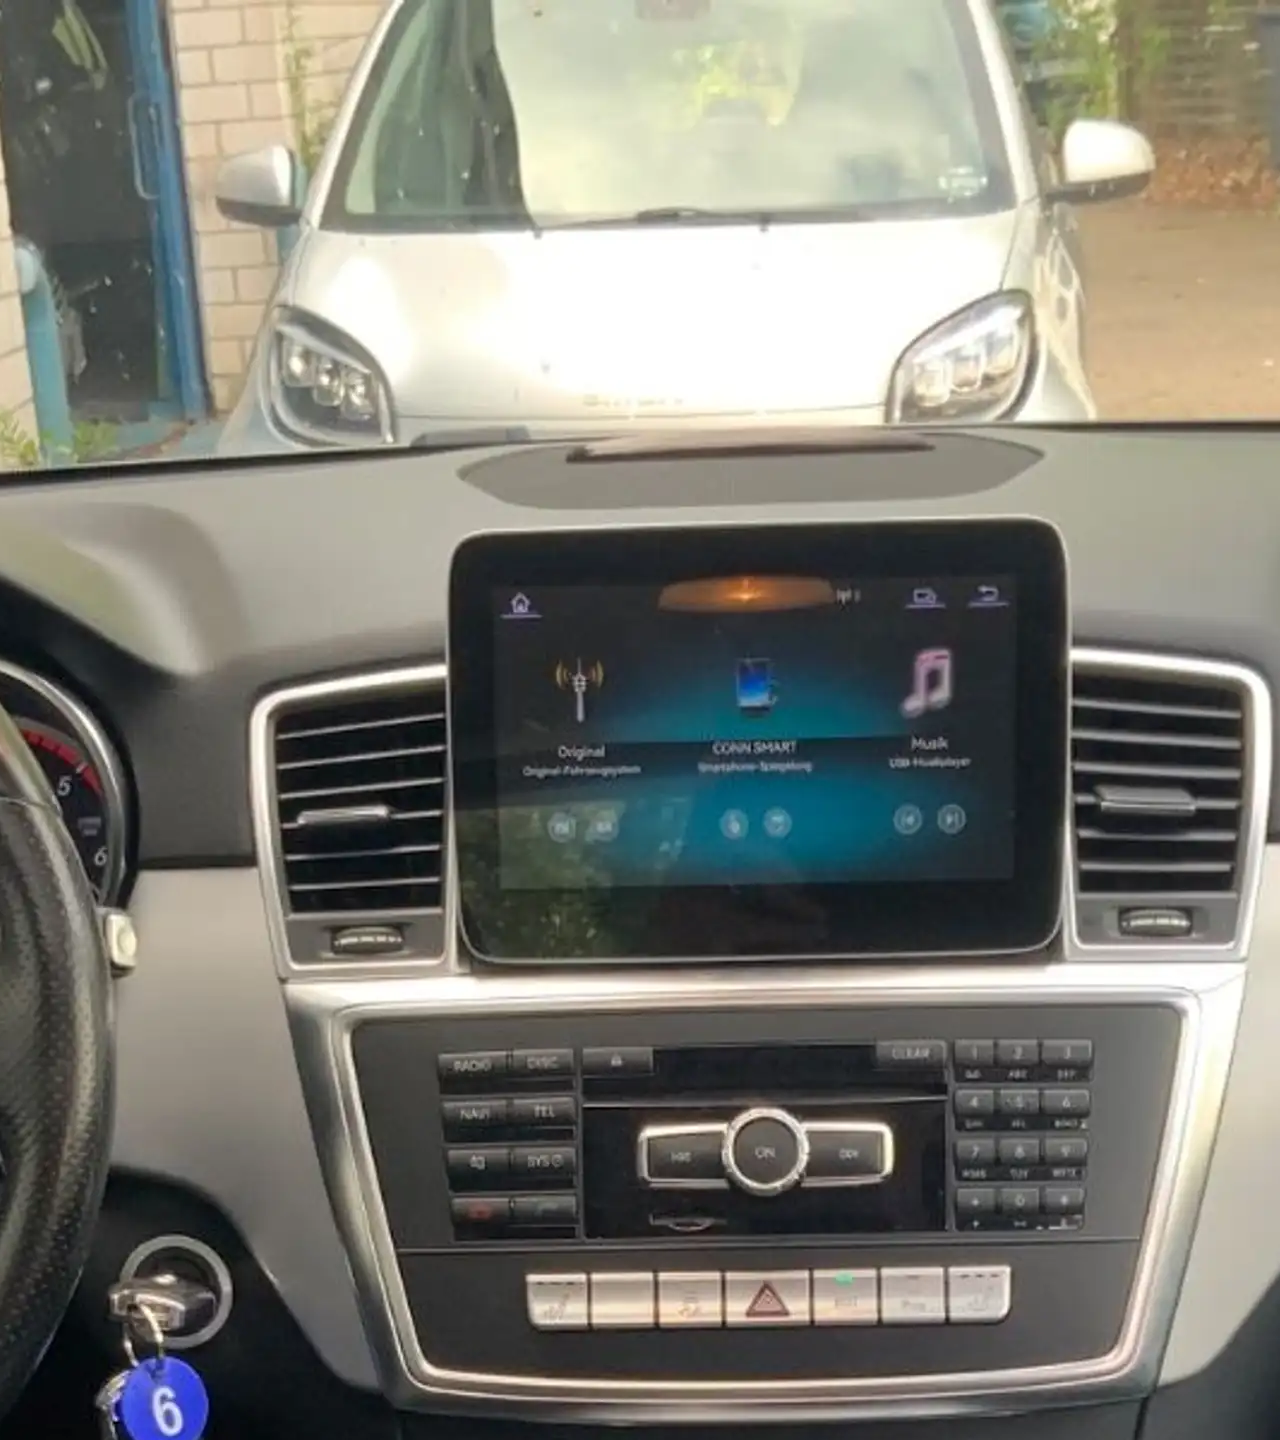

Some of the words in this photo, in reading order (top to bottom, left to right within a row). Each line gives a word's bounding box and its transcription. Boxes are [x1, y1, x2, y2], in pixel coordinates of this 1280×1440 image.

[753, 740, 797, 755] SMART
[911, 736, 949, 751] Musik
[558, 744, 606, 762] Original
[57, 775, 72, 796] 5
[93, 846, 108, 866] 6
[452, 1058, 493, 1073] RADIO
[754, 1146, 776, 1160] ON
[151, 1385, 184, 1437] 6
